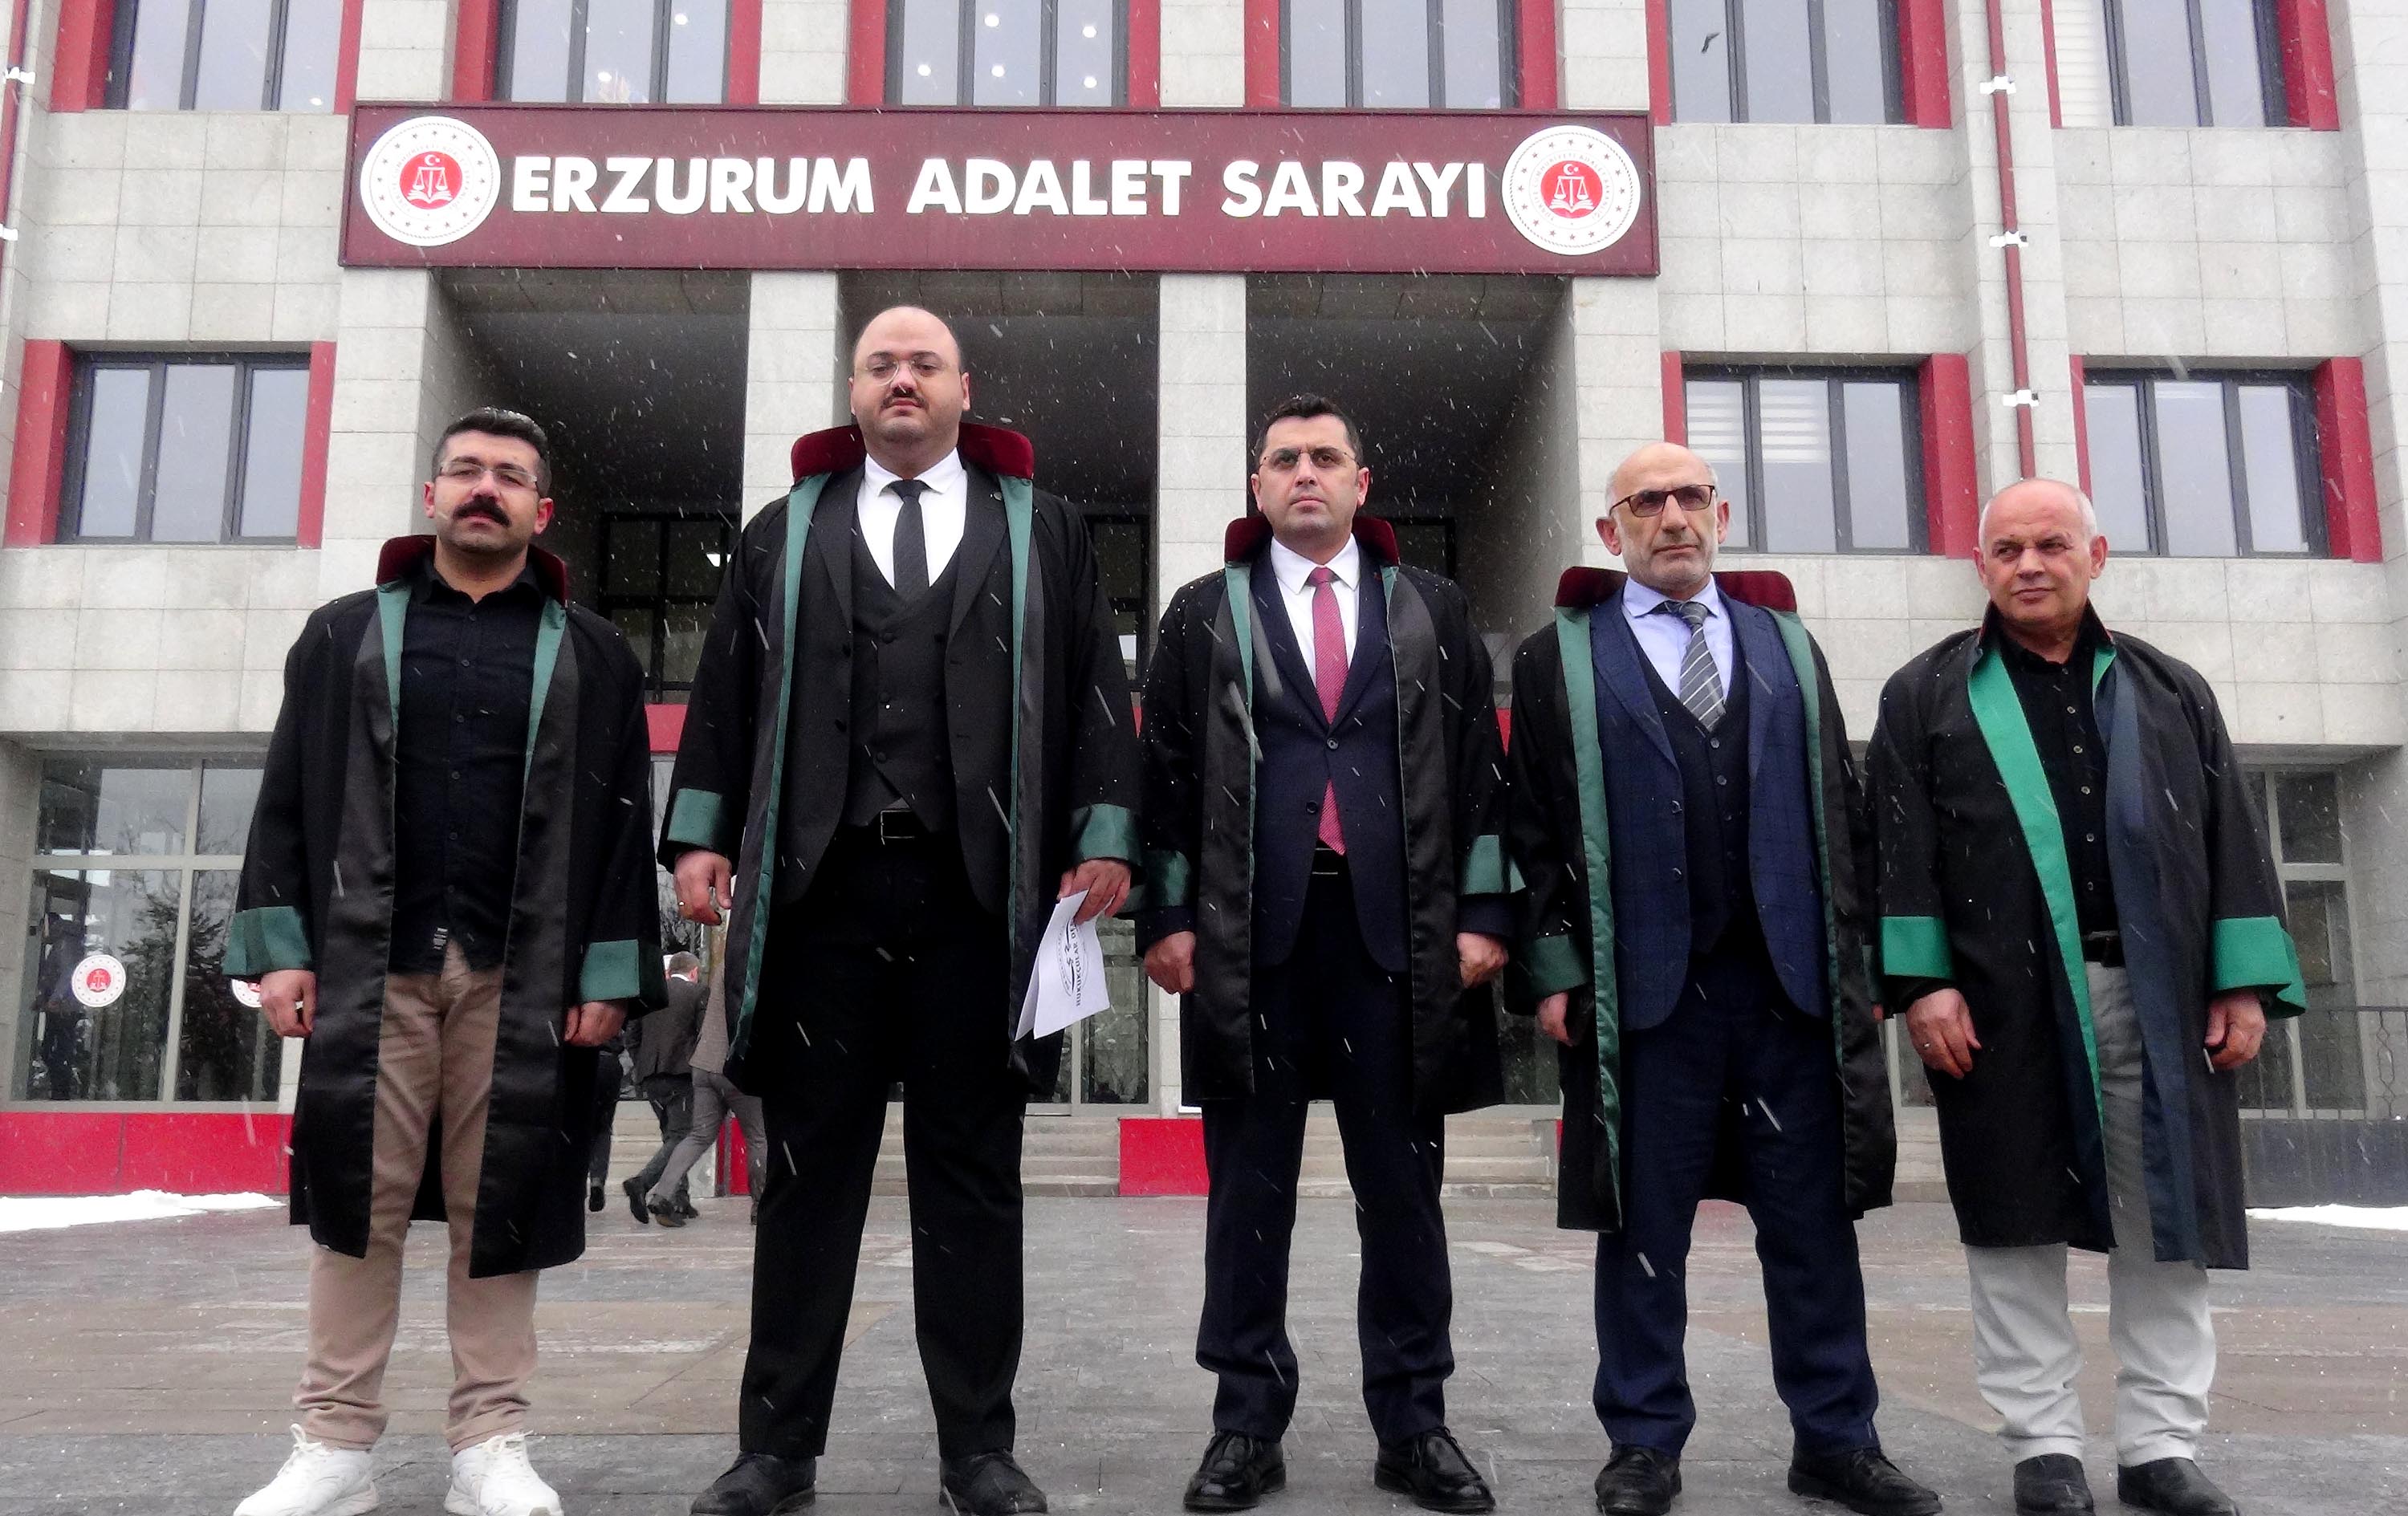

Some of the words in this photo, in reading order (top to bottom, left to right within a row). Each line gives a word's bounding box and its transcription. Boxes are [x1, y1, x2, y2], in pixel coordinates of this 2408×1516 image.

[511, 156, 875, 214] ERZURUM
[906, 158, 1192, 216] ADALET
[1221, 160, 1487, 218] SARAYI
